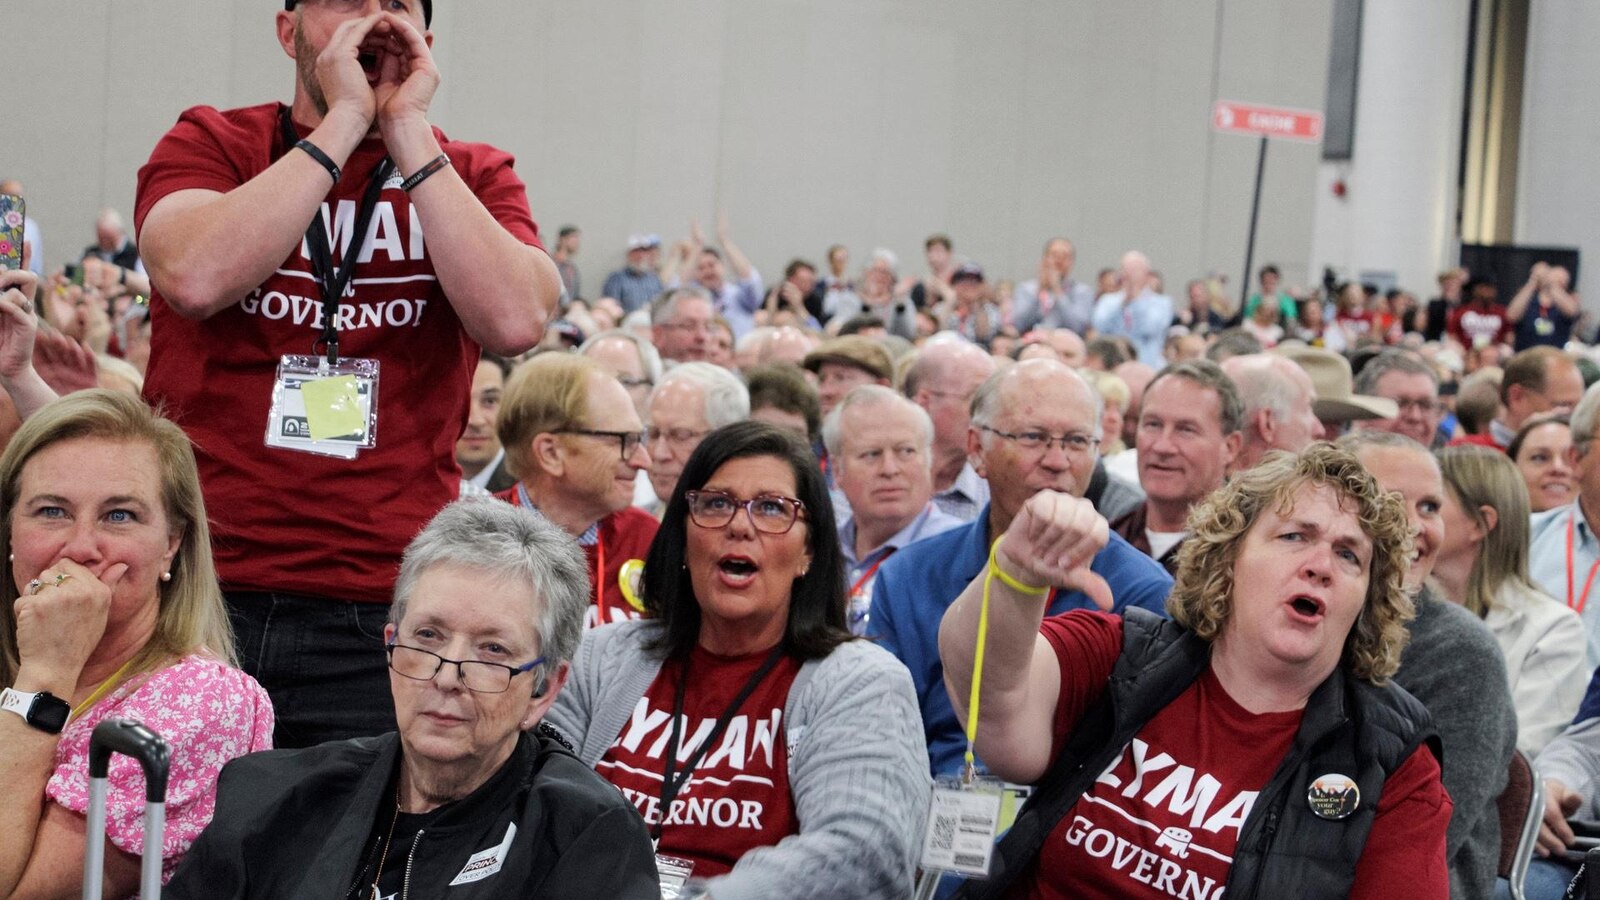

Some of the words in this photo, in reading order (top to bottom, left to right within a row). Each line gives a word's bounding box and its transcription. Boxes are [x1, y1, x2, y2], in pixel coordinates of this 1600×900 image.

[611, 696, 783, 771] YMAN
[613, 784, 764, 830] VERNOR
[1095, 737, 1260, 842] LYMA
[1065, 815, 1227, 900] GOVERN
